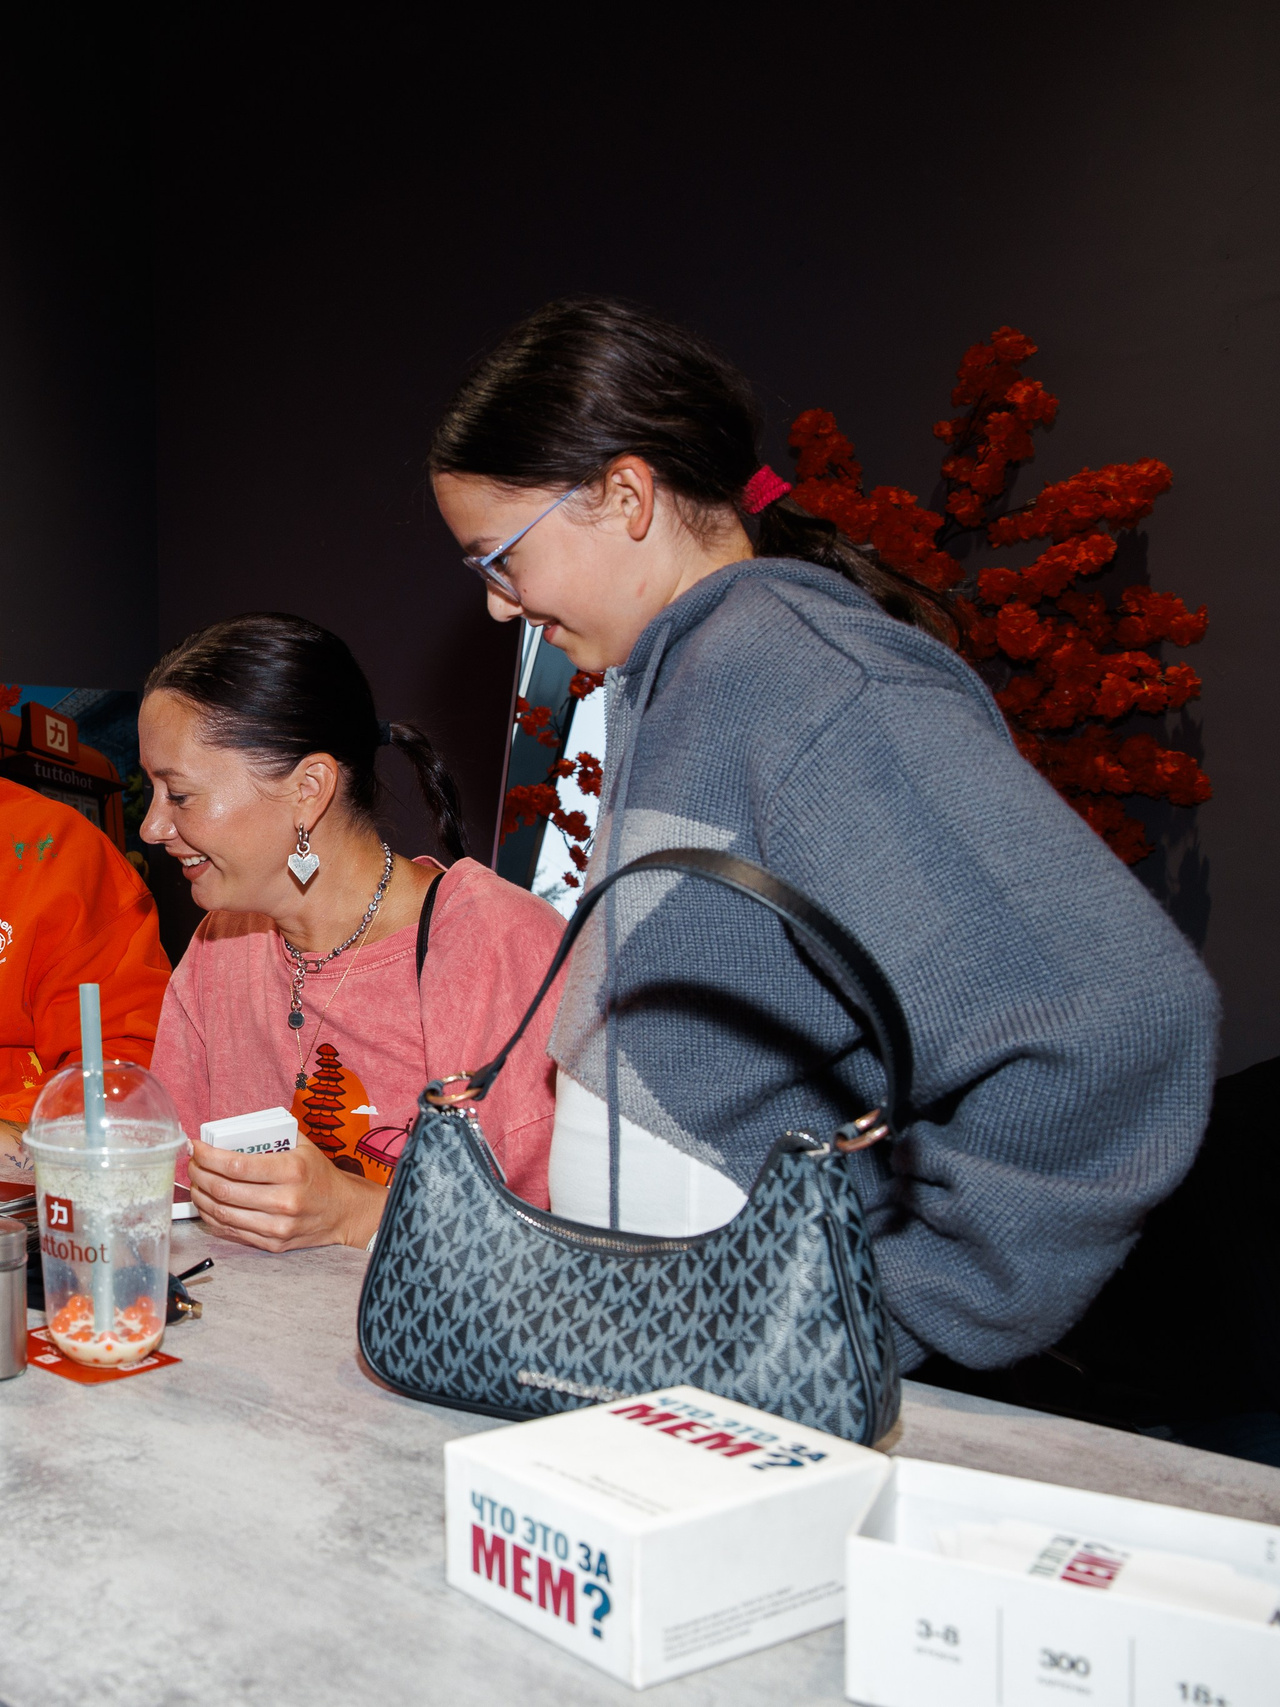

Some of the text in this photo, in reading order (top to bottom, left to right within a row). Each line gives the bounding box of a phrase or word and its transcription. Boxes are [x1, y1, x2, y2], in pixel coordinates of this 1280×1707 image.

[33, 761, 93, 791] tuttohot
[246, 1143, 271, 1154] ЭТО
[274, 1138, 290, 1149] ЗА
[608, 1403, 805, 1471] МЕМ?
[657, 1397, 829, 1462] ЧТО ЭТО ЗА
[471, 1490, 611, 1583] ЧТО ЭТО ЗА
[471, 1523, 612, 1640] МЕМ?
[1038, 1647, 1092, 1679] 300
